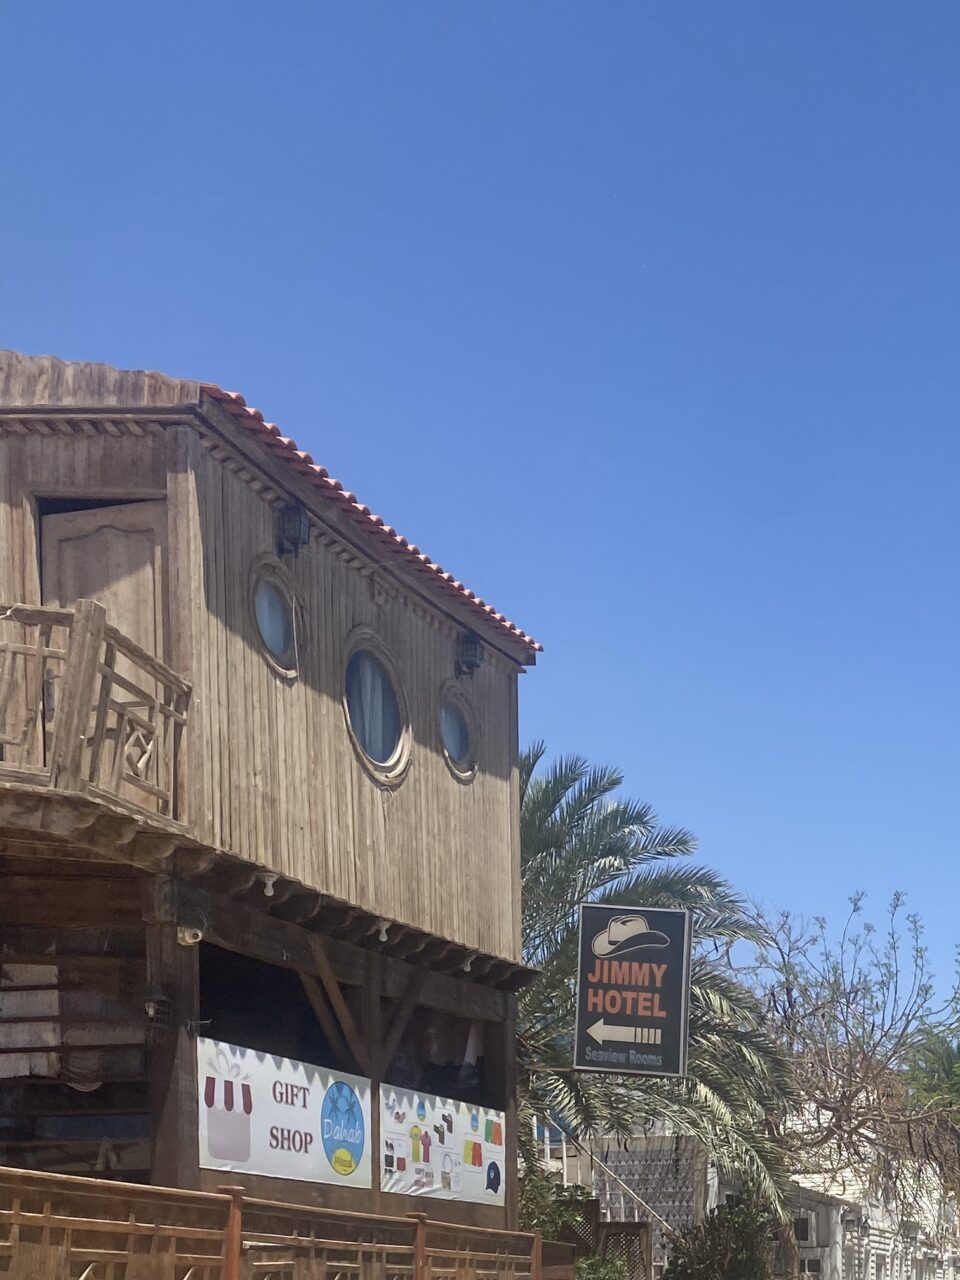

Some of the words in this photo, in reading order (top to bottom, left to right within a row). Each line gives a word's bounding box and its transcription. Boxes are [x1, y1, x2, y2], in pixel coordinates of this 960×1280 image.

[587, 959, 668, 988] JIMMY
[587, 988, 667, 1018] HOTEL
[585, 1046, 627, 1064] Seaview
[629, 1050, 663, 1066] Rooms
[272, 1080, 310, 1109] GIFT
[269, 1125, 313, 1154] SHOP
